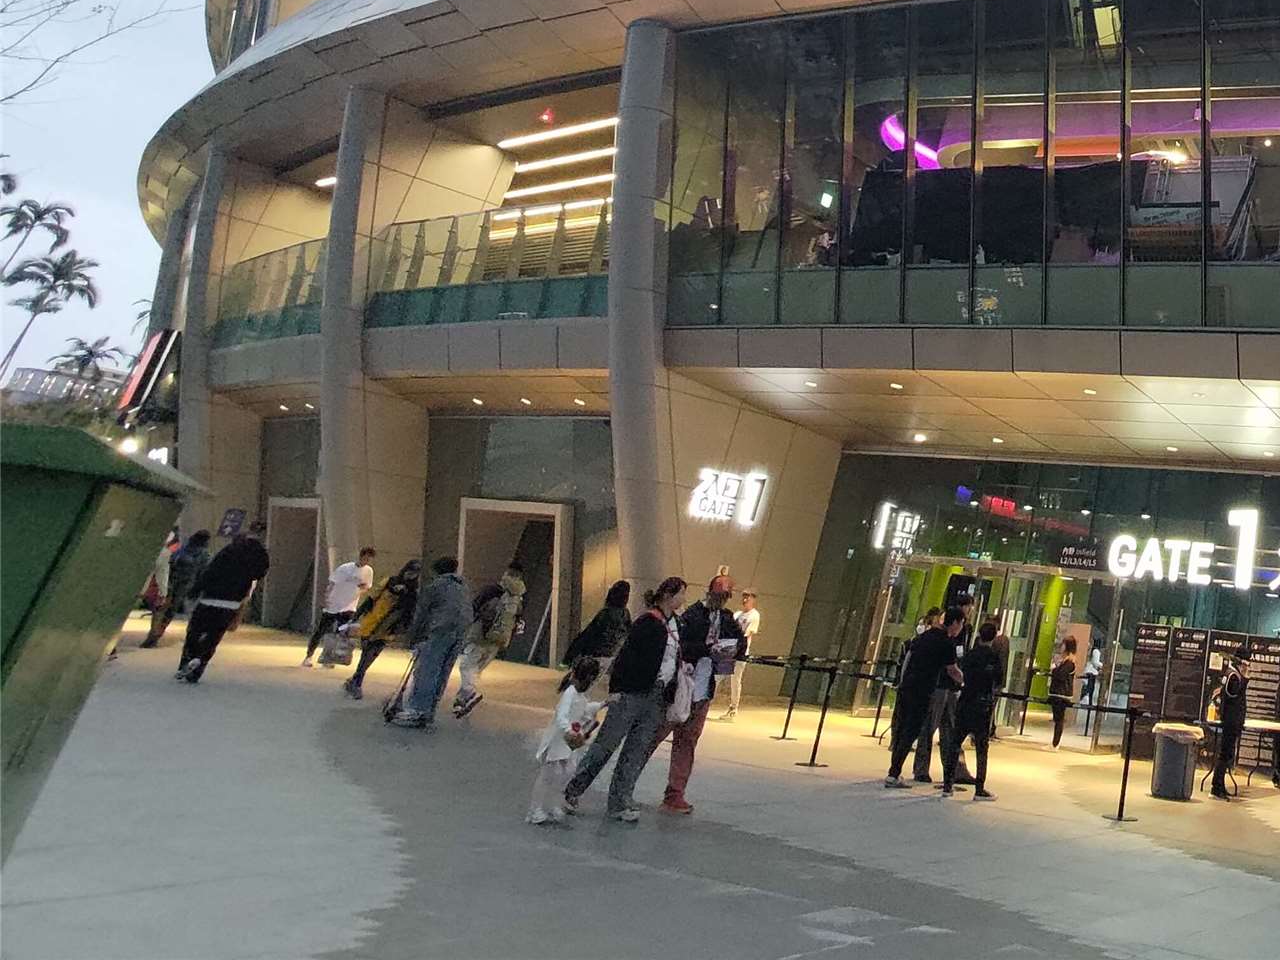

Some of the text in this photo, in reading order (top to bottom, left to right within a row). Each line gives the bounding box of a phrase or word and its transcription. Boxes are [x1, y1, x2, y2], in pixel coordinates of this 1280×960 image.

[699, 497, 737, 517] GATE
[1108, 535, 1214, 585] GATE
[1228, 509, 1259, 590] 1
